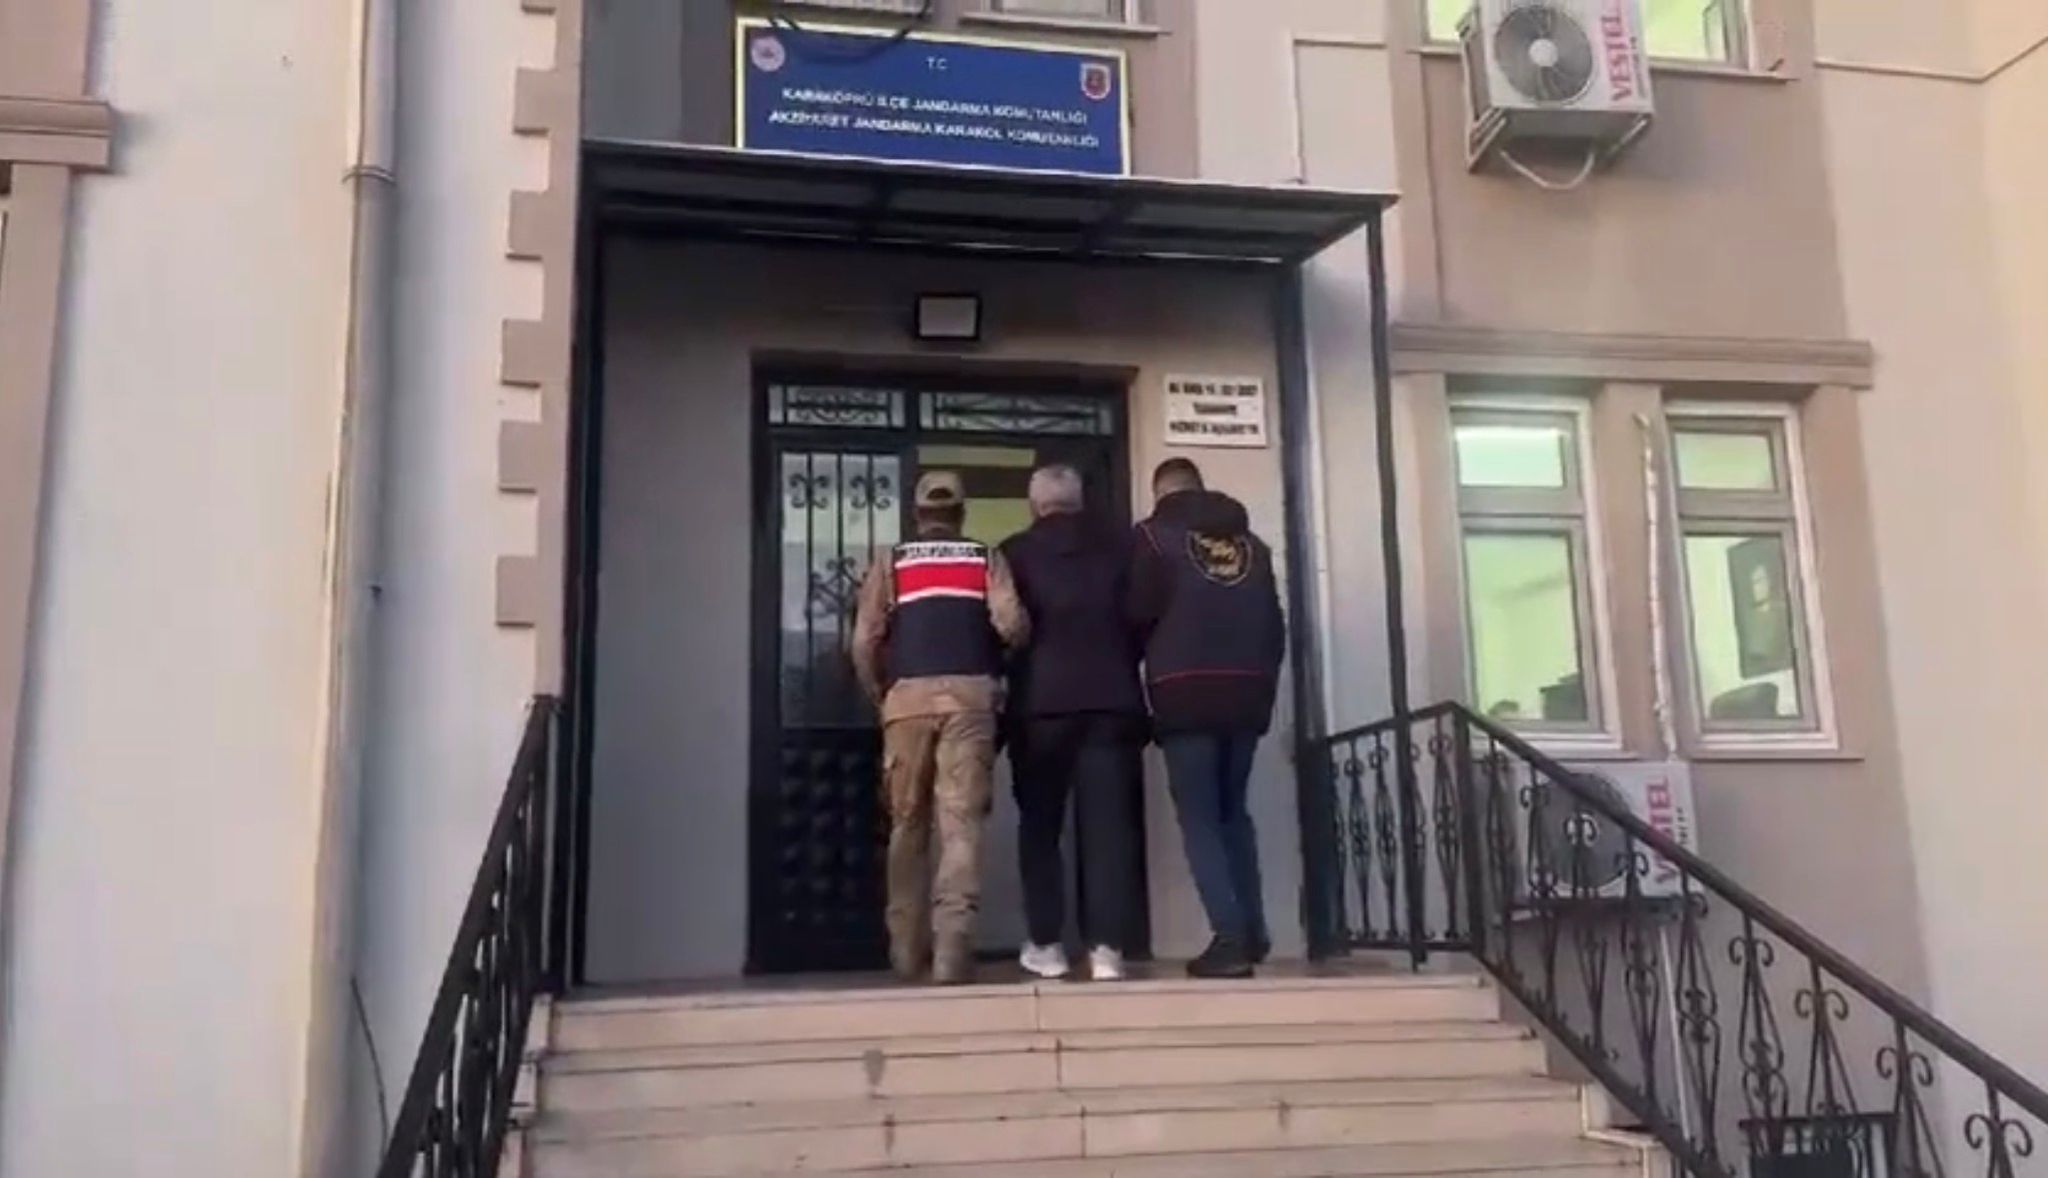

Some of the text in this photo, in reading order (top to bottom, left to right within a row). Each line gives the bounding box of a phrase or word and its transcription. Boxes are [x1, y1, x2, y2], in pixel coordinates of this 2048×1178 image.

[1600, 7, 1632, 101] VESTEL
[912, 98, 991, 117] JANDARMA
[852, 115, 932, 134] JANDARMA
[933, 121, 1004, 140] KARAKOL
